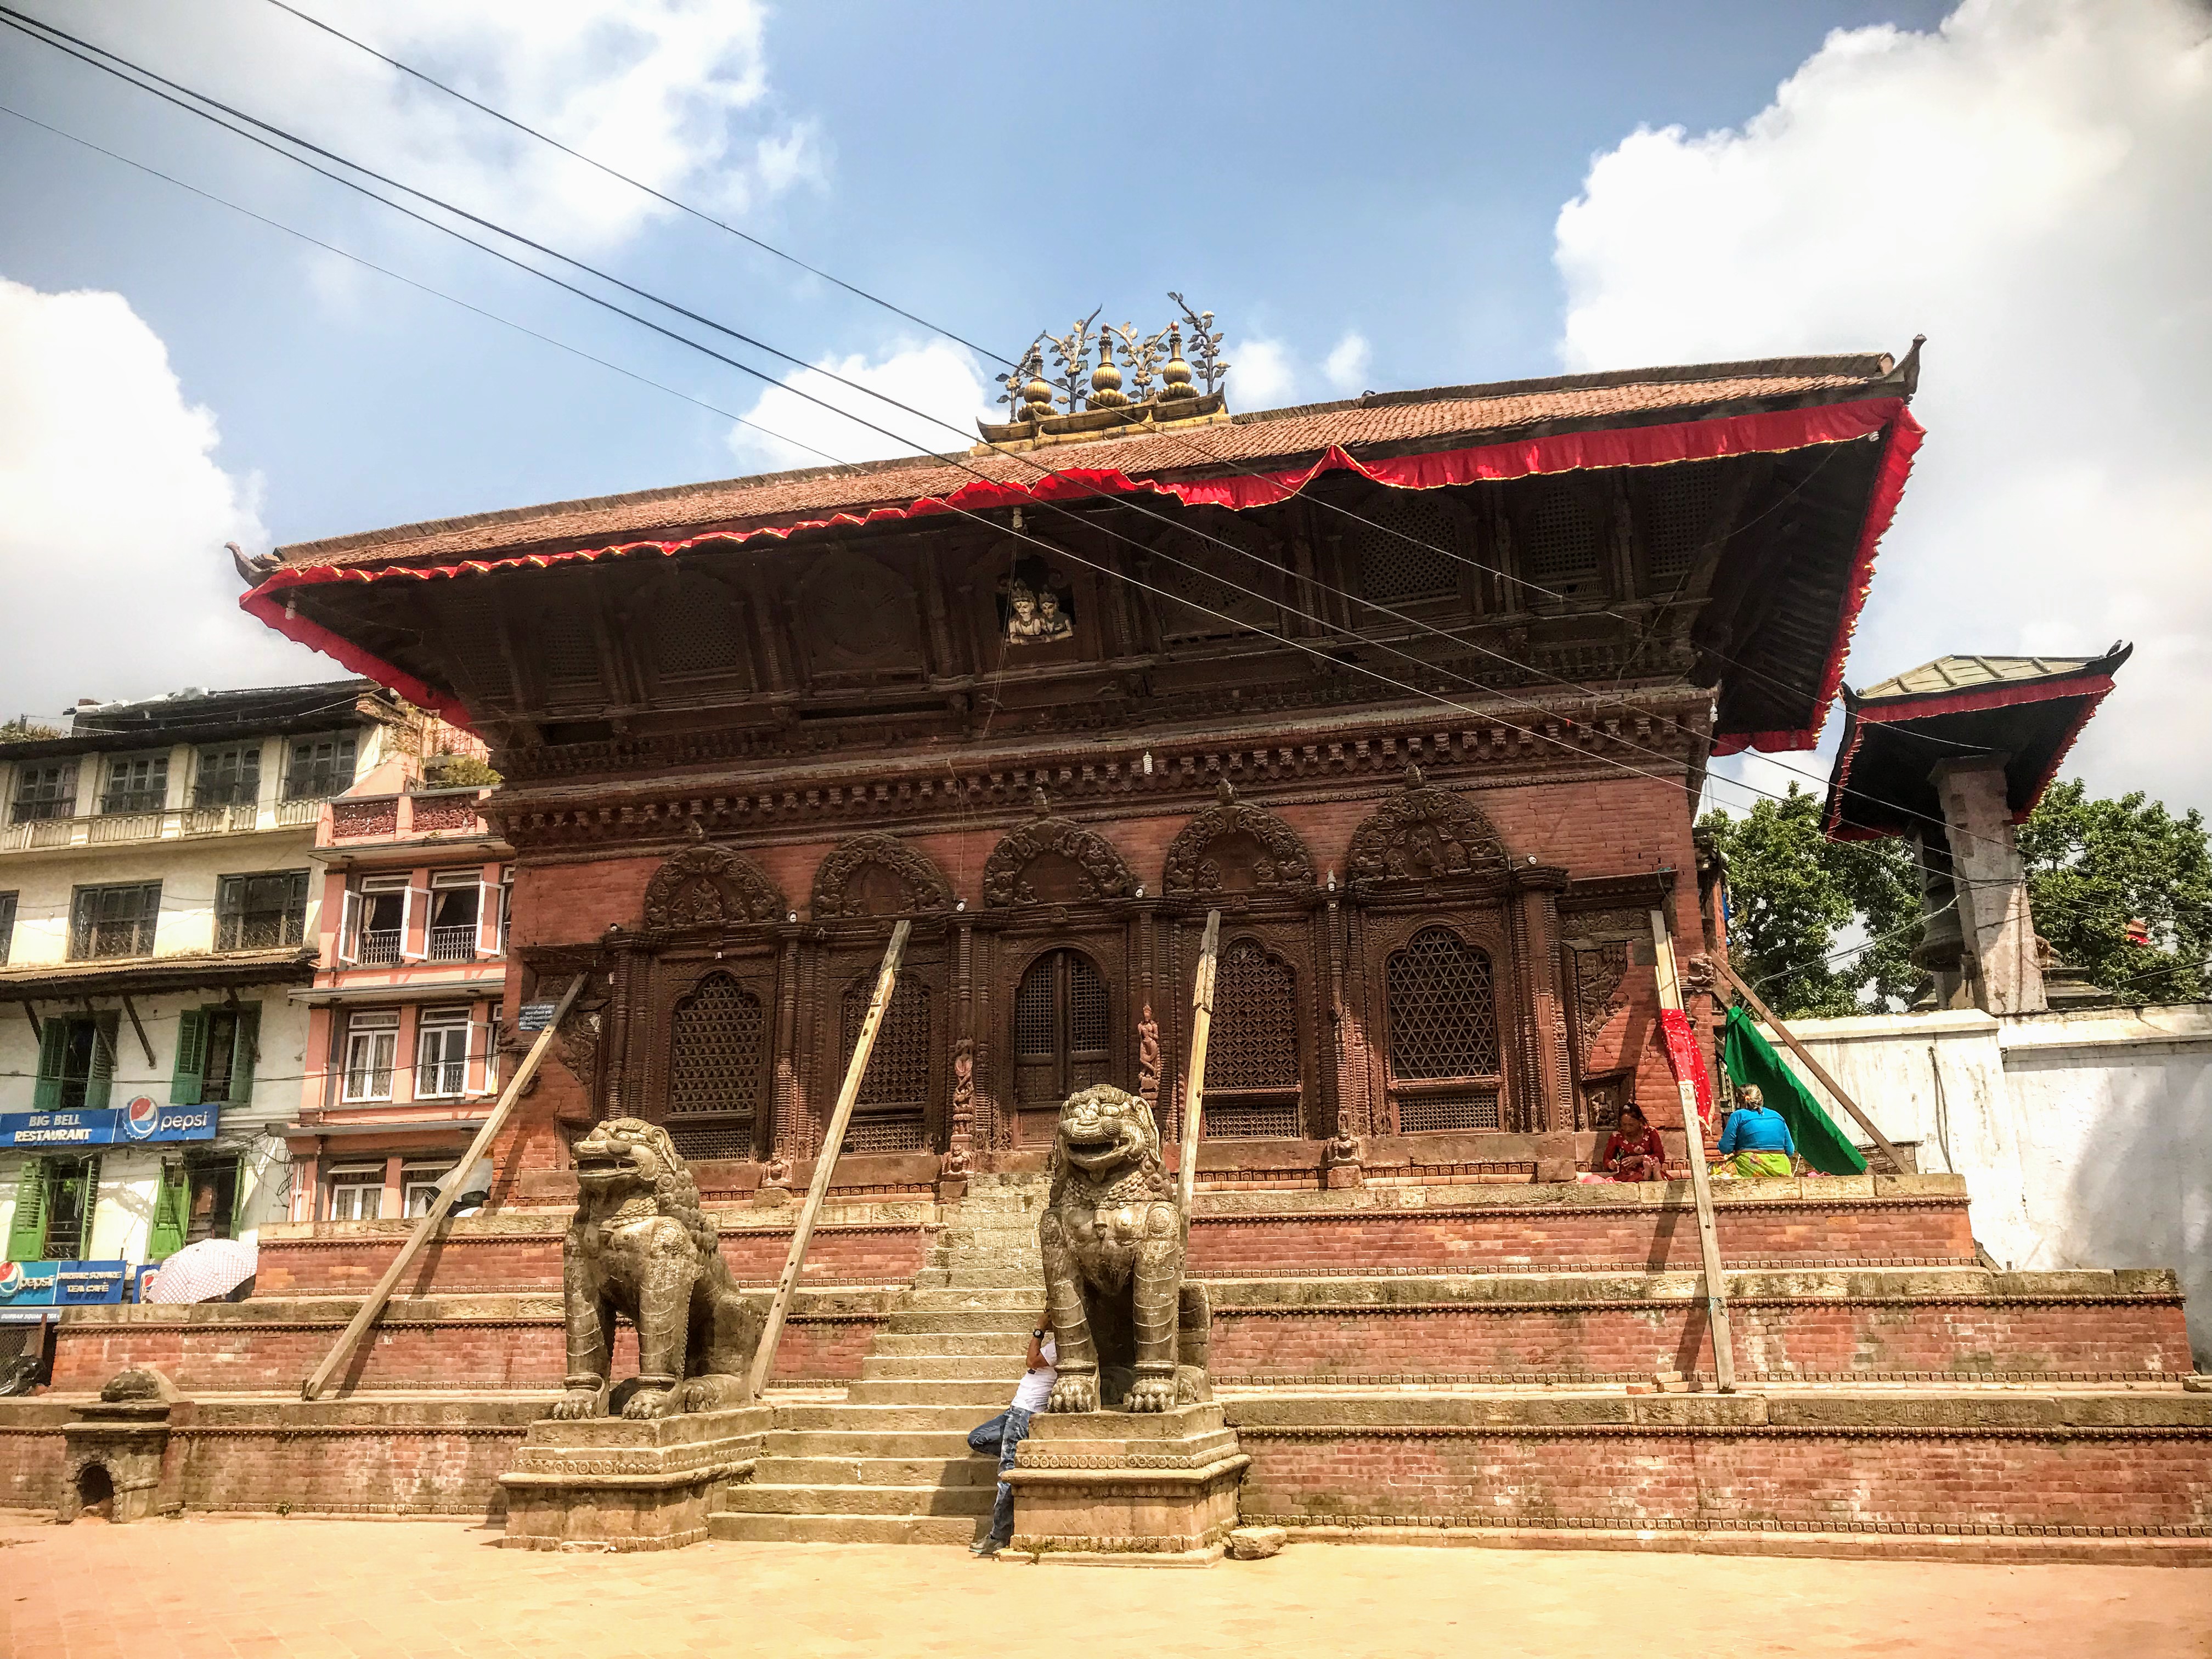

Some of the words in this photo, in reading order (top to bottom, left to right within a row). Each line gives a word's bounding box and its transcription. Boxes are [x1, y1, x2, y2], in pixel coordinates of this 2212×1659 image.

[29, 1115, 50, 1127] BIG
[54, 1114, 81, 1126] BELL
[160, 1111, 207, 1131] pepsi
[14, 1128, 93, 1142] RESTAURANT
[19, 1274, 55, 1290] pepsi
